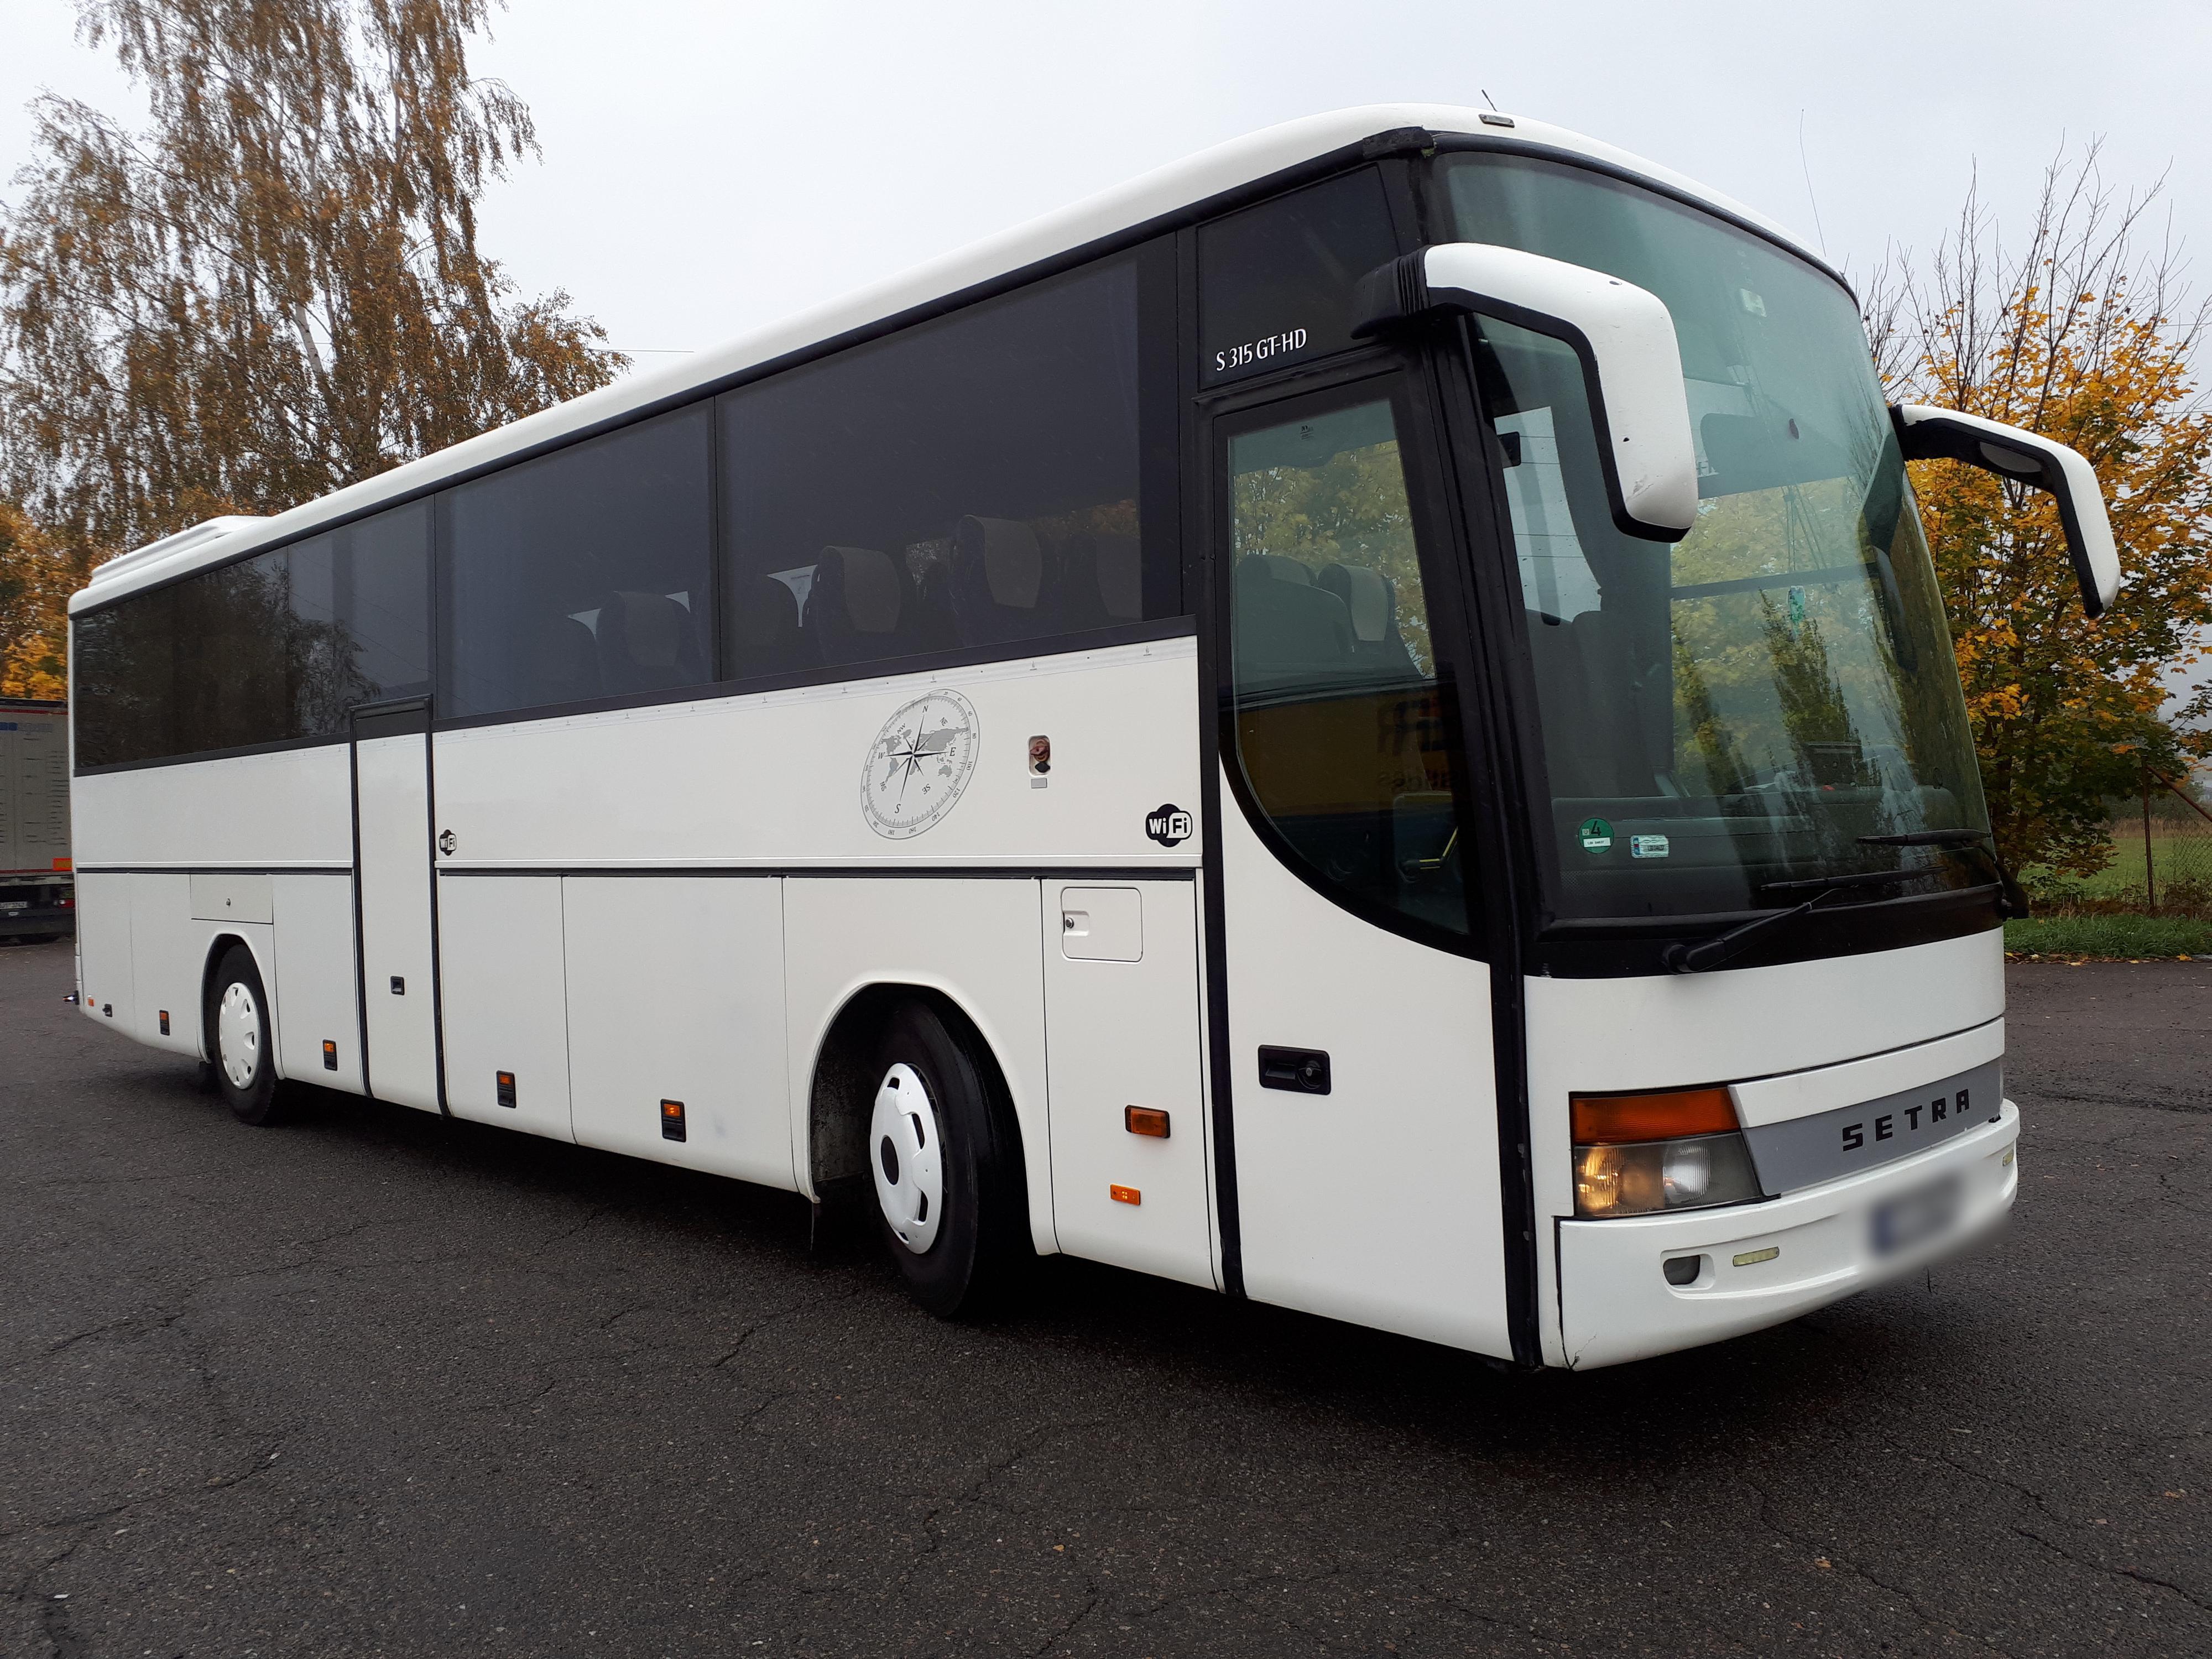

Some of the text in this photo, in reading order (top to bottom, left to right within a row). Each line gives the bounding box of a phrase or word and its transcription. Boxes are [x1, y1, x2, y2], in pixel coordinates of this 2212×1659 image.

[1217, 328, 1307, 371] S 315 GT-HD
[950, 747, 956, 757] E
[922, 783, 931, 795] SE
[952, 787, 961, 798] 120
[894, 804, 901, 813] S
[931, 812, 940, 821] 140
[1591, 821, 1601, 836] 4
[1842, 1089, 1970, 1152] SETRA
